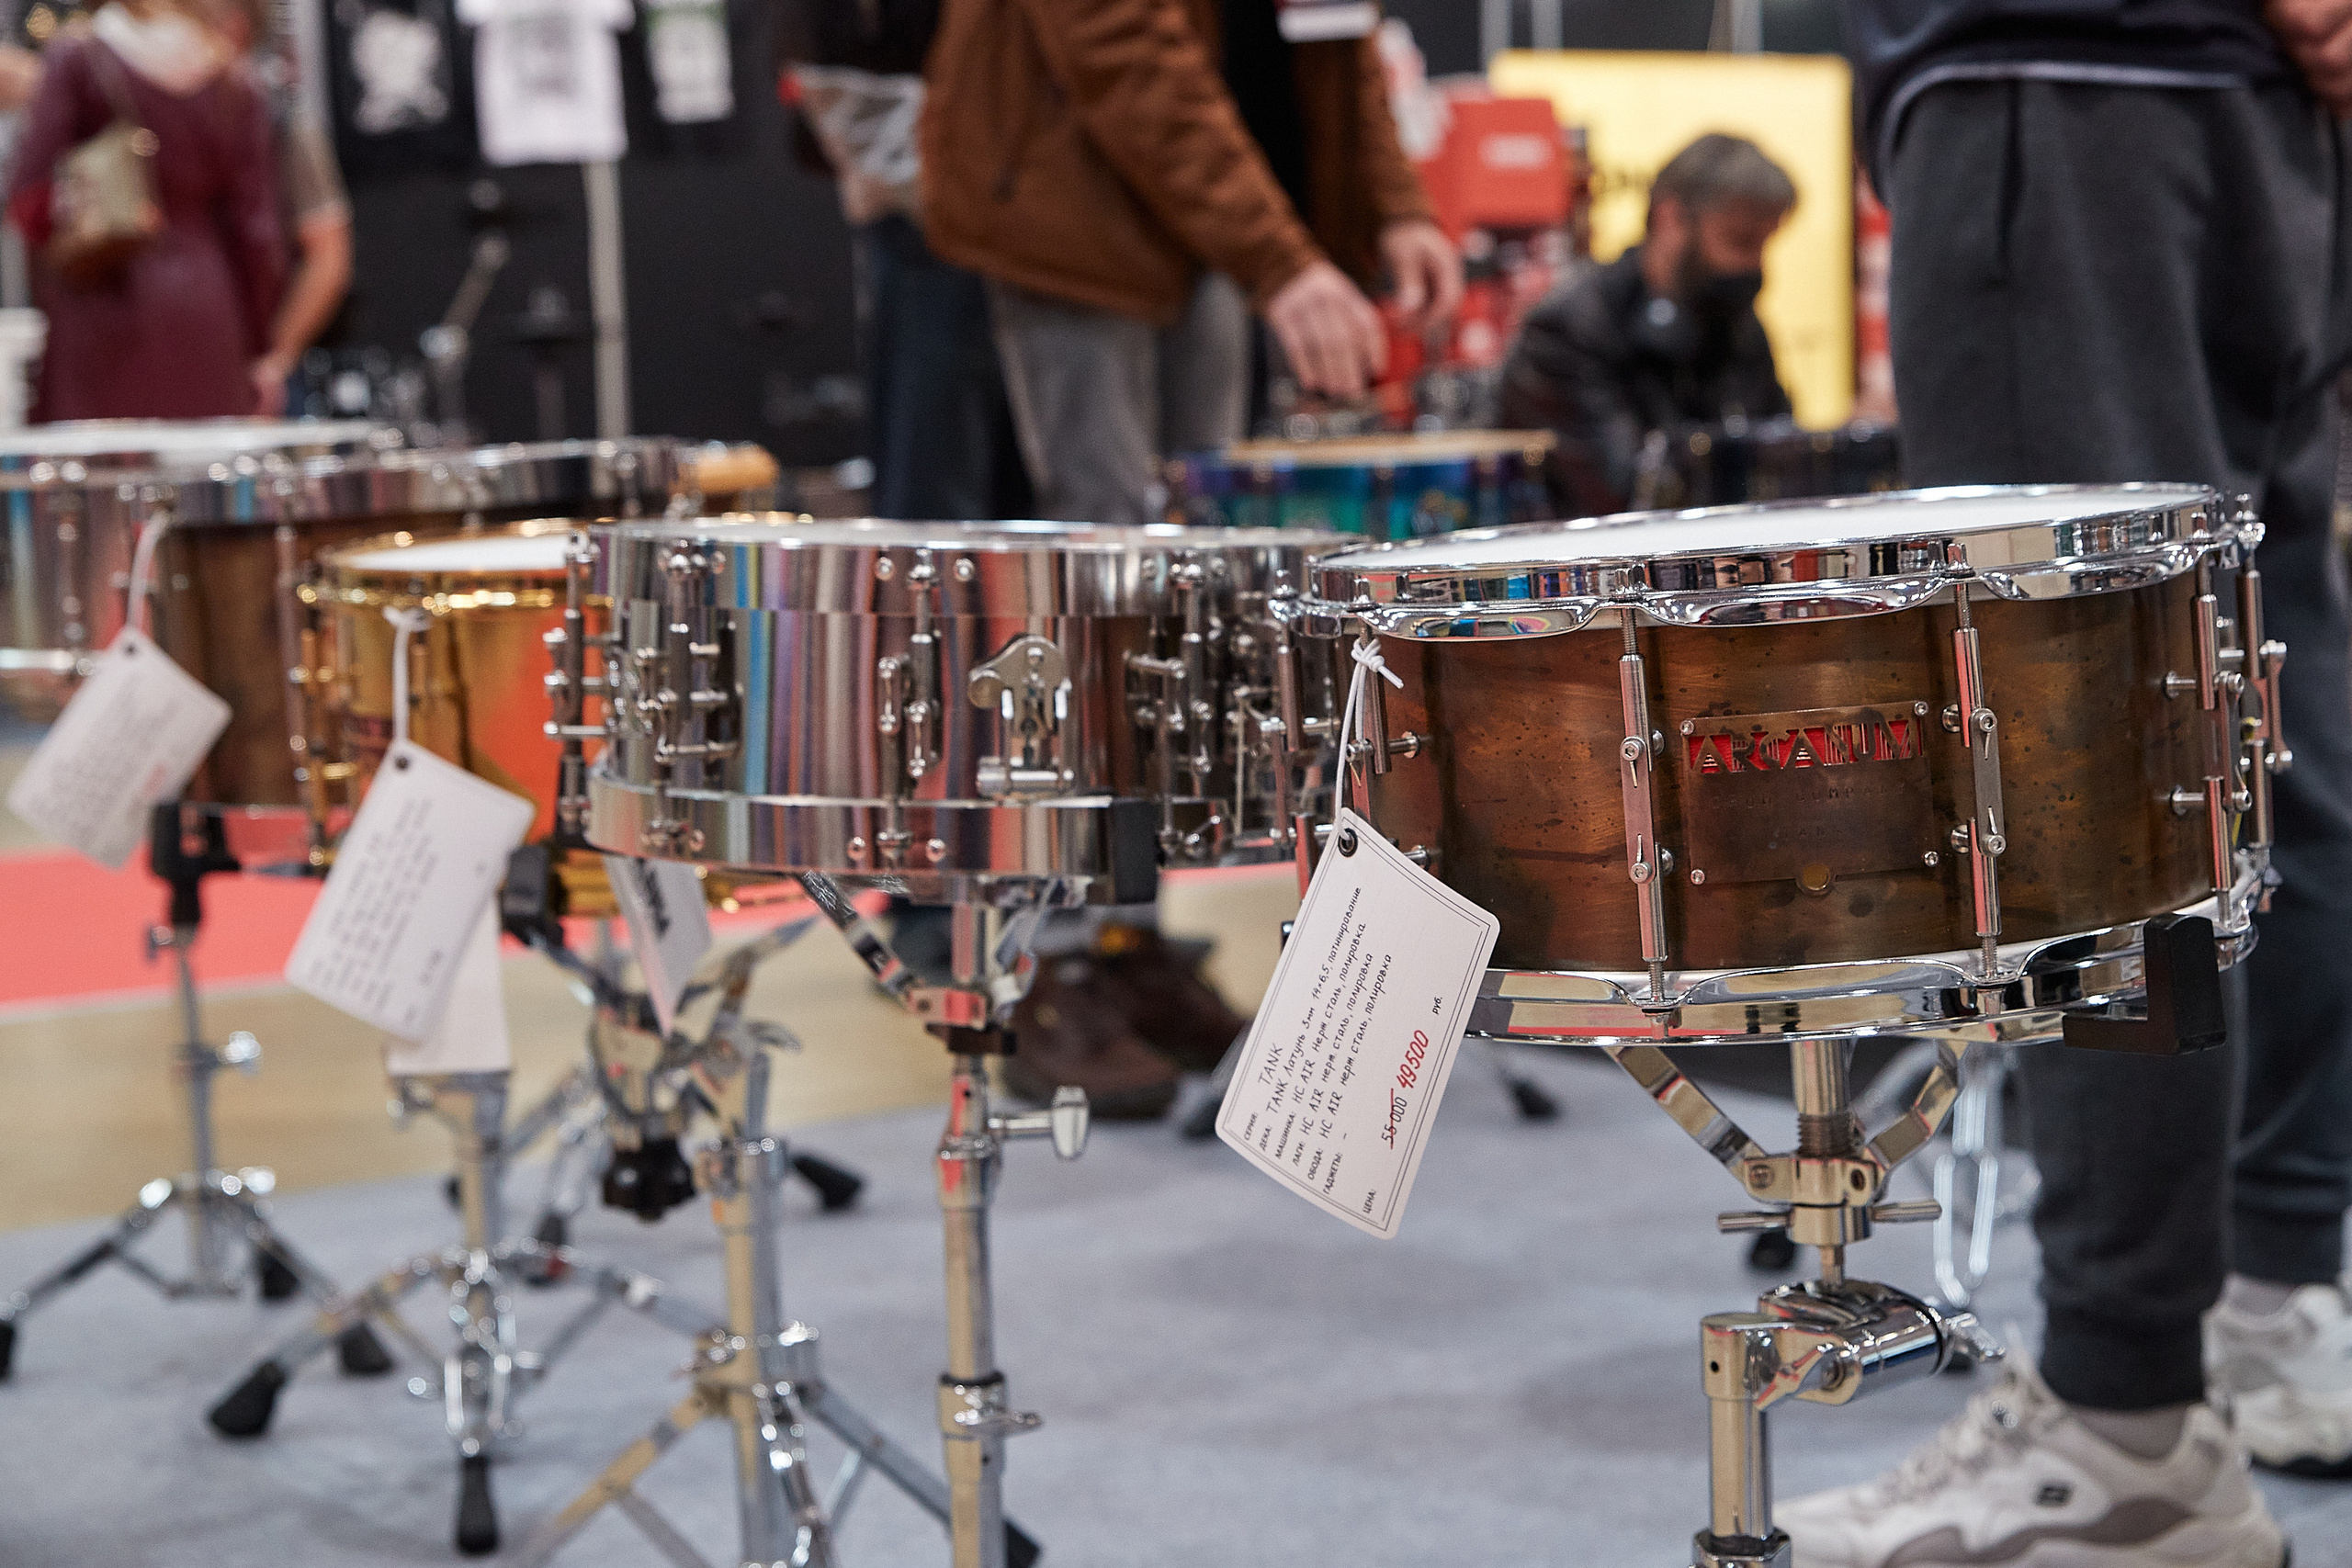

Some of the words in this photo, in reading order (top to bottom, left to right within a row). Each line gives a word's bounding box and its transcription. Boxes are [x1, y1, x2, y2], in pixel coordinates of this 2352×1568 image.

[1690, 719, 1921, 774] ARCANUM
[1328, 886, 1362, 964] патинирование
[1274, 1111, 1296, 1159] МАШИНКА:
[1299, 1059, 1316, 1084] AIR
[1339, 923, 1366, 982] полировка
[1283, 1033, 1306, 1077] Латунь
[1292, 1140, 1306, 1167] ЛАГИ:
[1308, 1088, 1324, 1112] AIR
[1346, 953, 1374, 1011] полировка
[1307, 1148, 1324, 1180] ОБОДА:
[1327, 1091, 1343, 1116] AIR
[1364, 953, 1392, 1015] полировка
[1243, 1111, 1259, 1141] СЕРИЯ:
[1257, 1043, 1283, 1085] TANK
[1265, 1077, 1288, 1113] TANK
[1362, 1189, 1377, 1214] ЦЕНА:
[1431, 996, 1442, 1015] руб.
[1259, 1125, 1272, 1152] ДЕКА:
[1322, 1151, 1343, 1195] ГАДЖЕТЫ:
